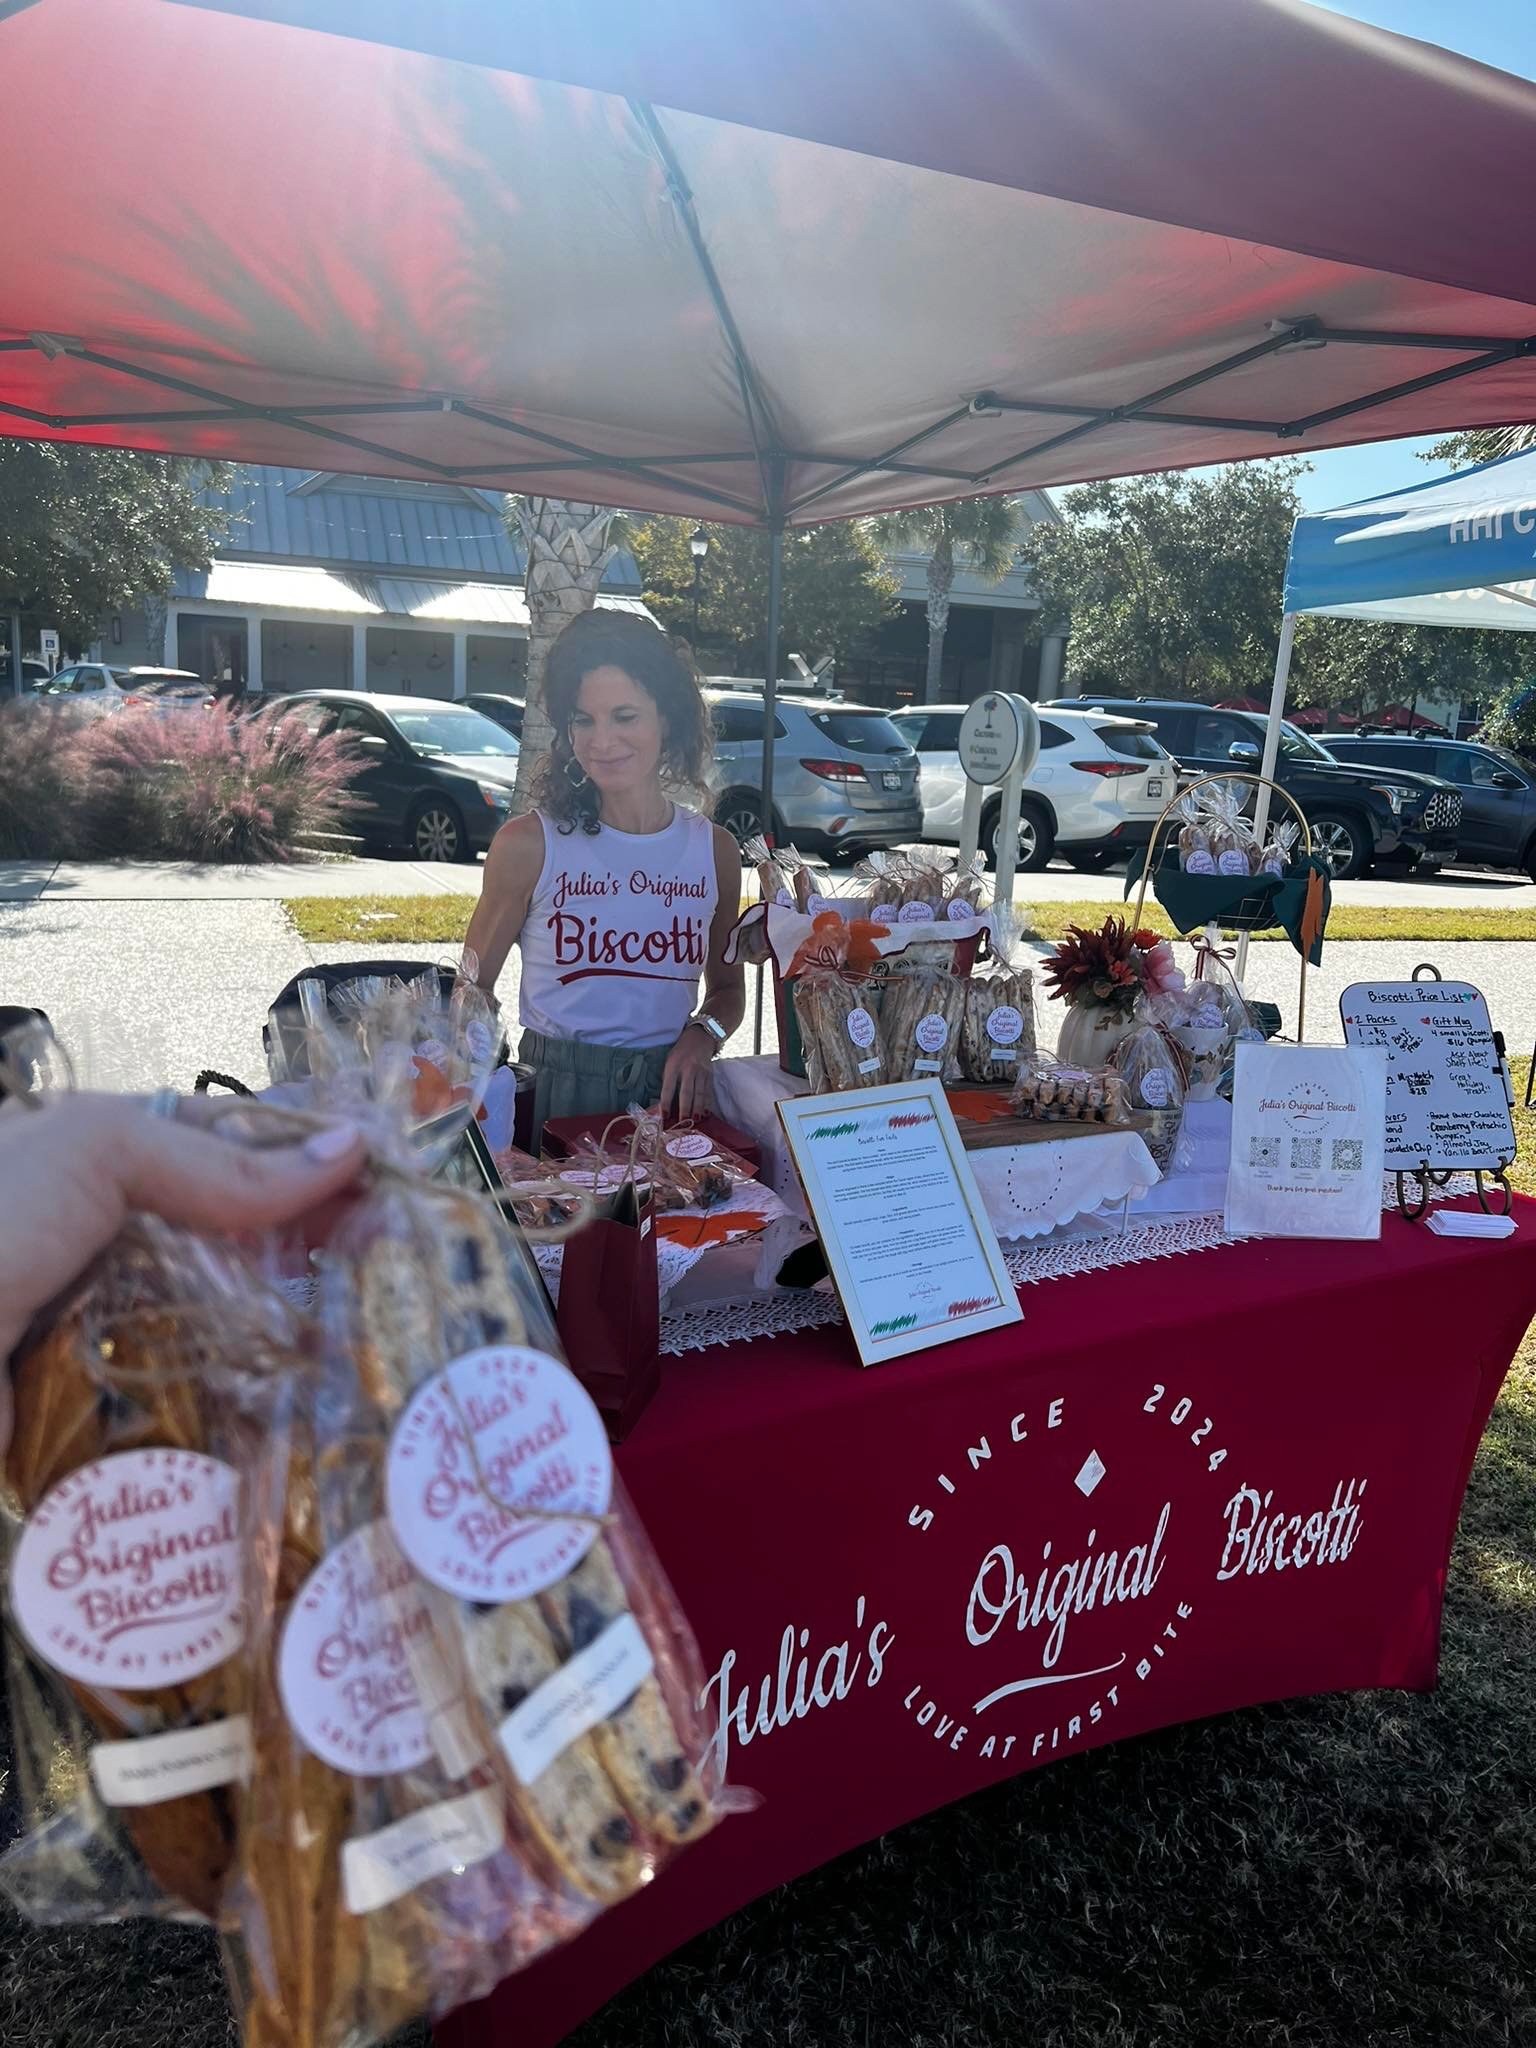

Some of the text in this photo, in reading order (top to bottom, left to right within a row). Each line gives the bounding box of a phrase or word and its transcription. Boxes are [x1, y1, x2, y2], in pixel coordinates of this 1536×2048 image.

[553, 870, 708, 908] Julia's Original
[547, 910, 706, 966] Biscotti
[1368, 988, 1465, 1002] Biscotti Price List
[1354, 1014, 1396, 1024] 2 Packs
[1432, 1016, 1472, 1030] Gift Mug
[1259, 1099, 1357, 1114] Julia's Original Biscotti
[1409, 1087, 1427, 1095] $28
[1430, 1120, 1507, 1134] Cranberry Pistachio
[908, 1384, 1227, 1531] SINCE 2024
[70, 1473, 195, 1549] Julia's
[46, 1505, 236, 1591] Original
[77, 1559, 230, 1631] Biscotti
[695, 1595, 895, 1785] Julia's
[965, 1502, 1171, 1669] Original
[1216, 1478, 1367, 1581] Biscotti
[903, 1601, 1193, 1759] LOVE AT FIRST BITE
